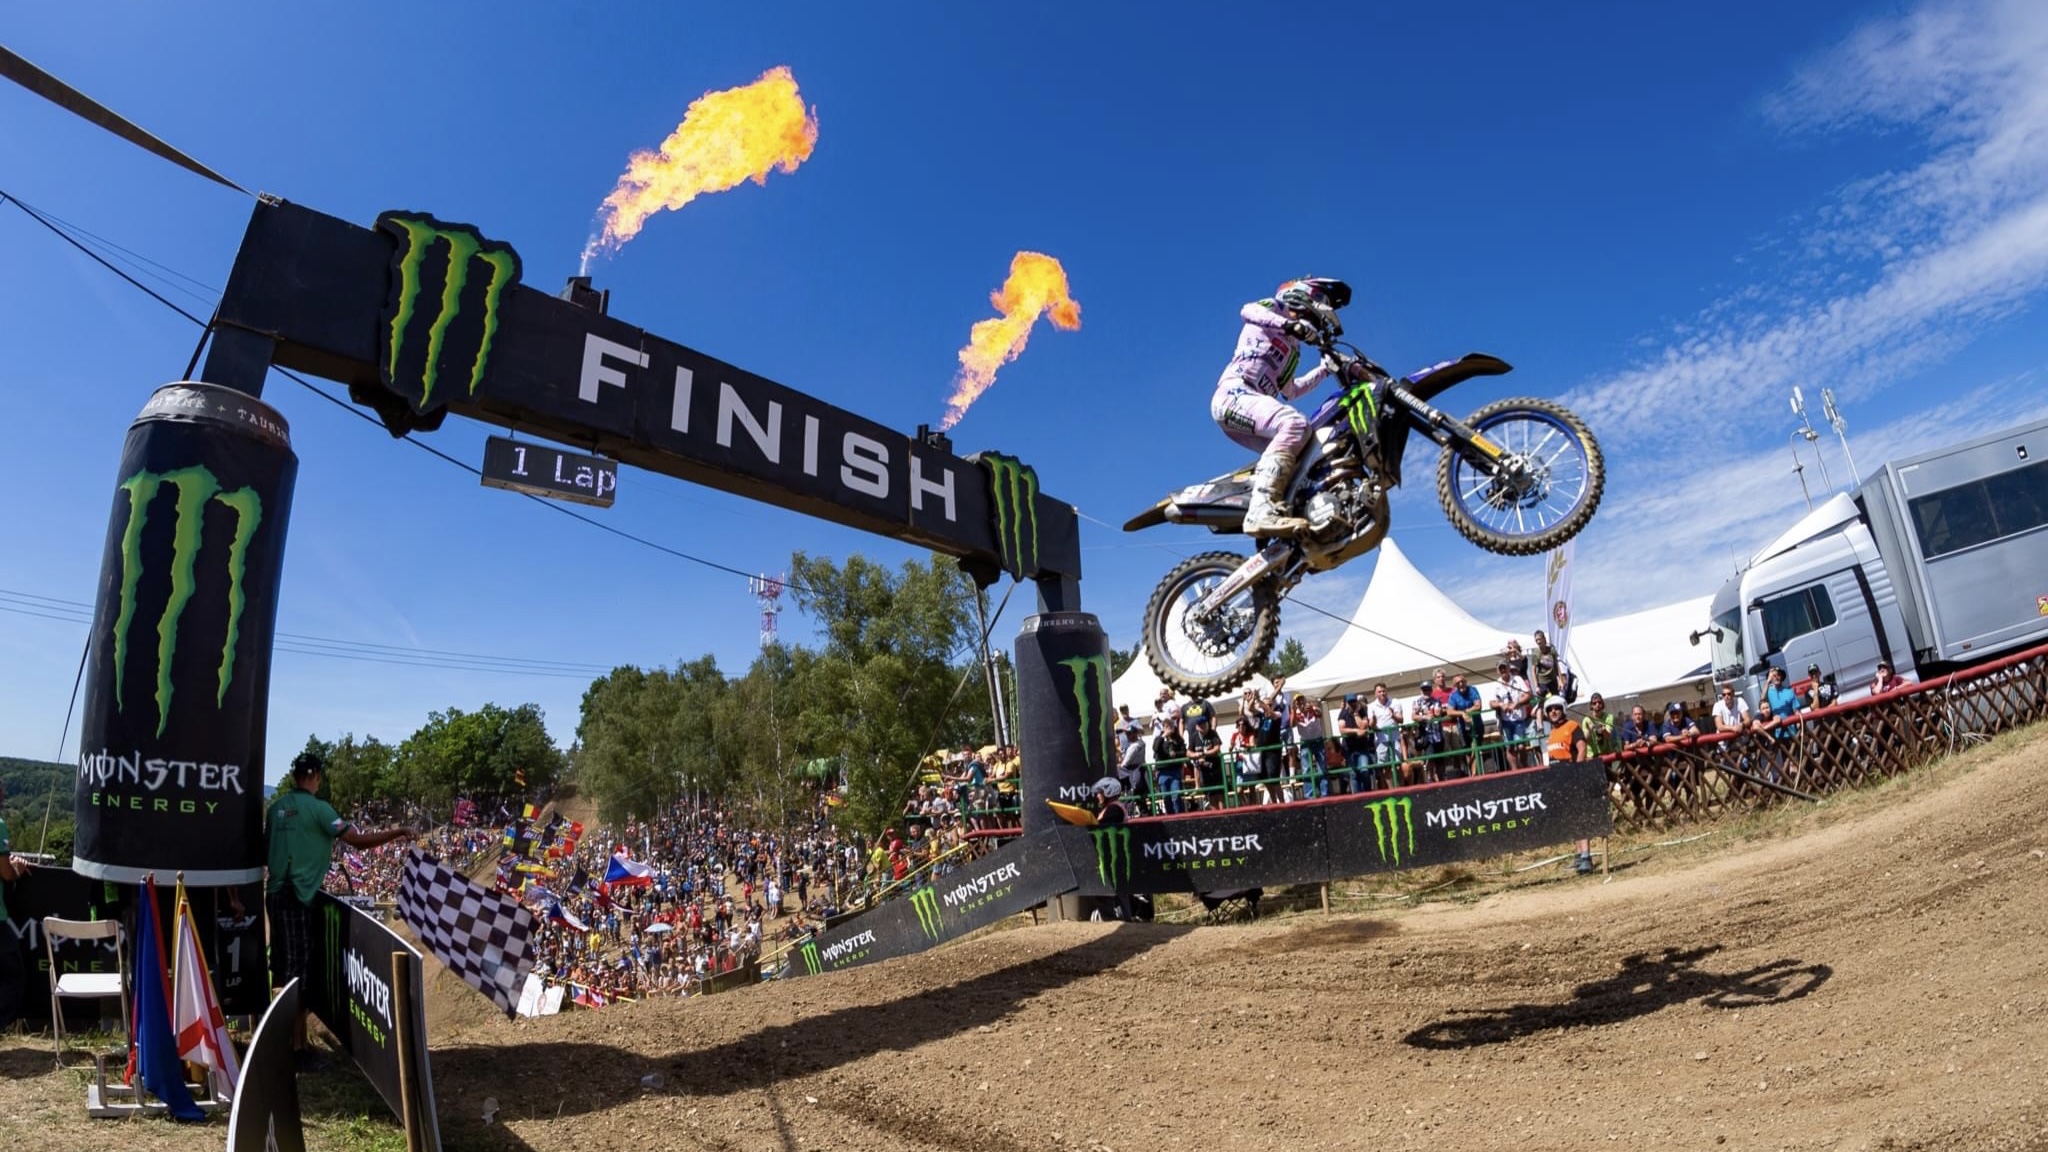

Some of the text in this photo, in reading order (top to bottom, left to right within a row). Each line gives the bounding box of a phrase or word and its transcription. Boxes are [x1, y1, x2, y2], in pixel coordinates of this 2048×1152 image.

[578, 333, 957, 522] FINISH
[512, 447, 616, 497] 1 Lap
[81, 748, 245, 795] MONSTER
[92, 792, 218, 814] ENERGY
[1425, 792, 1548, 828] MONSTER
[1447, 817, 1531, 839] ENERGY
[1143, 834, 1263, 860] MONSTER
[1162, 857, 1246, 870] ENERGY
[943, 862, 1021, 907] MONSTER
[960, 884, 1013, 915] ENERGY
[227, 936, 241, 973] 1
[822, 929, 876, 962] MONSTER
[833, 947, 871, 969] ENERGY
[343, 947, 393, 1030] MONSTER
[349, 998, 386, 1049] ENERGY
